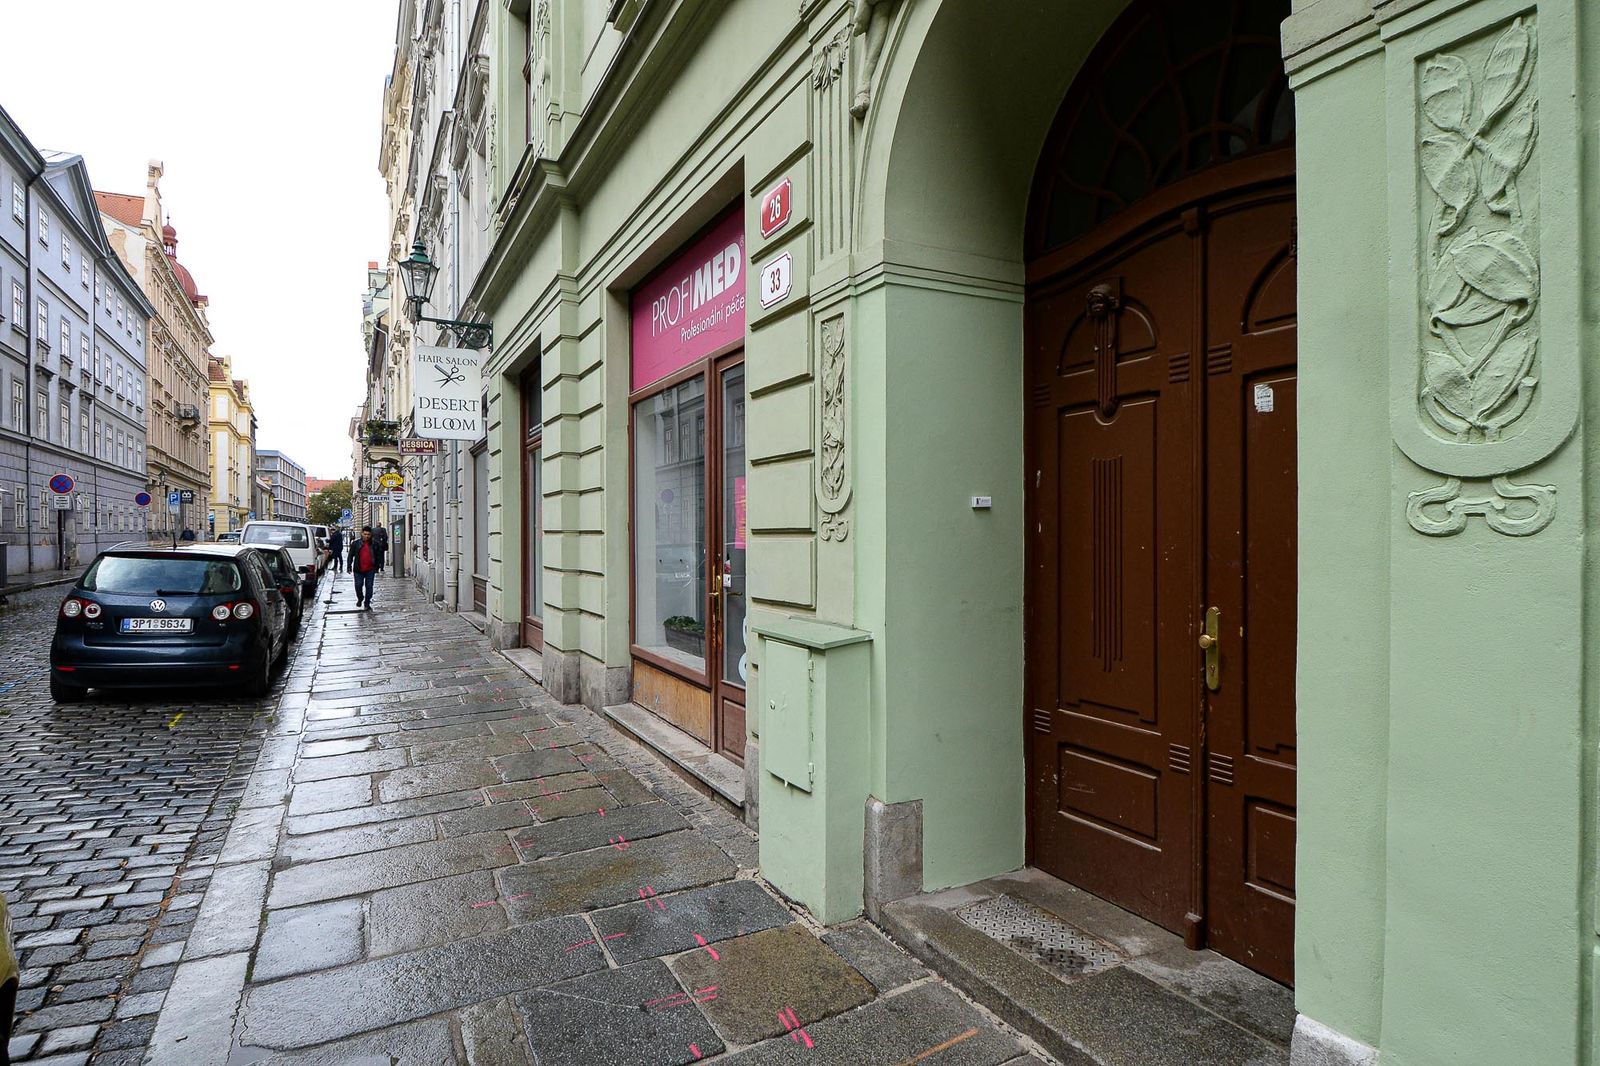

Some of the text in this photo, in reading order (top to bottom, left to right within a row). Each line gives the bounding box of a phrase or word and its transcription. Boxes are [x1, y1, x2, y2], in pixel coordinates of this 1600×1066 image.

[770, 194, 781, 223] 26
[770, 268, 781, 294] 33
[681, 293, 745, 343] Profesionální péče
[418, 354, 479, 367] HAIR SALON
[418, 396, 480, 413] DESERT
[422, 416, 476, 432] BLOOM
[401, 440, 434, 449] JESSICA
[170, 493, 177, 502] P
[132, 619, 151, 629] 3P1
[160, 619, 186, 629] 9634
